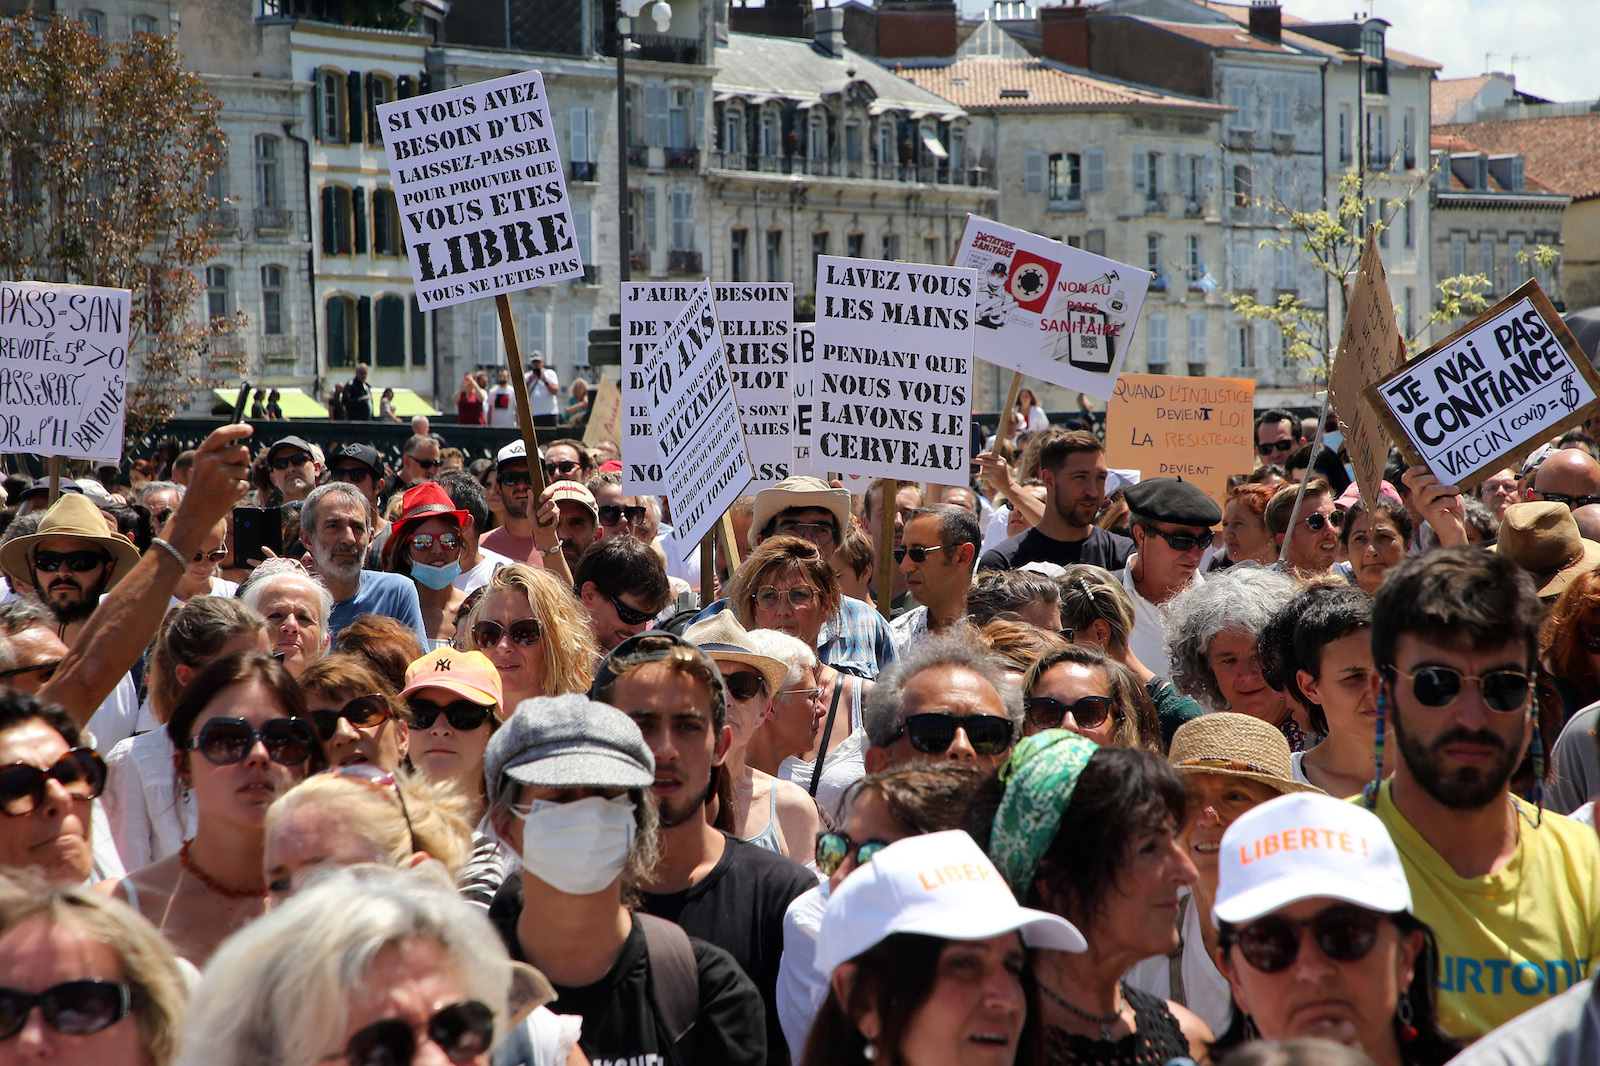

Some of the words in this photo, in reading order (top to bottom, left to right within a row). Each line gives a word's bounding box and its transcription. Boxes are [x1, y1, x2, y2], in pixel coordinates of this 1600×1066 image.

[388, 110, 412, 132] SI
[416, 96, 476, 126] VOUS
[483, 82, 538, 111] AVEZ
[392, 123, 481, 160] BESOIN
[488, 109, 544, 140] D'UN
[398, 137, 551, 184] LAISSEZ-PASSER
[403, 186, 446, 206] POUR
[449, 168, 522, 196] PROUVER
[526, 161, 557, 178] QUE
[406, 199, 483, 234] VOUS
[490, 181, 562, 216] ETES
[413, 212, 573, 282] LIBRE
[423, 283, 464, 303] VOUS
[469, 278, 490, 294] NE
[494, 266, 545, 288] L'ETES
[549, 259, 579, 277] PAS
[715, 287, 789, 302] BESOIN
[826, 265, 900, 291] LAVEZ
[907, 272, 971, 298] VOUS
[1058, 281, 1087, 293] NON
[1091, 284, 1111, 296] AU
[629, 320, 657, 336] DE
[824, 296, 873, 321] LES
[881, 302, 968, 330] MAINS
[1040, 319, 1121, 337] SANITAIRE
[1067, 301, 1098, 313] PASS
[644, 347, 664, 377] NOUS
[664, 287, 709, 351] ATTENDRONS
[648, 362, 672, 408] 70
[678, 304, 715, 378] ANS
[823, 344, 920, 370] PENDANT
[925, 355, 967, 374] QUE
[1387, 375, 1429, 414] JE
[1493, 310, 1546, 360] PAS
[656, 409, 677, 437] AVANT
[677, 394, 687, 410] DE
[686, 371, 704, 397] NOUS
[704, 346, 723, 377] FAIRE
[659, 364, 728, 458] VACCINER
[750, 405, 789, 416] SONT
[821, 373, 890, 398] NOUS
[898, 380, 966, 406] VOUS
[1113, 378, 1165, 403] QUAND
[1170, 385, 1252, 404] L'INJUSTICE
[71, 373, 124, 452] BAFOUÉS
[687, 441, 702, 461] TEMPS
[715, 412, 725, 426] ONT
[724, 401, 733, 414] MIS
[821, 401, 923, 432] LAVONS
[931, 413, 963, 436] LE
[671, 473, 689, 499] POUR
[688, 429, 723, 477] DECOUVRIR
[723, 412, 737, 434] QUE
[820, 433, 963, 470] CERVEAU
[1131, 427, 1153, 447] LA
[678, 501, 706, 540] ETAIT
[705, 450, 747, 507] TOXIQUE
[1239, 827, 1354, 866] LIBERTÉ
